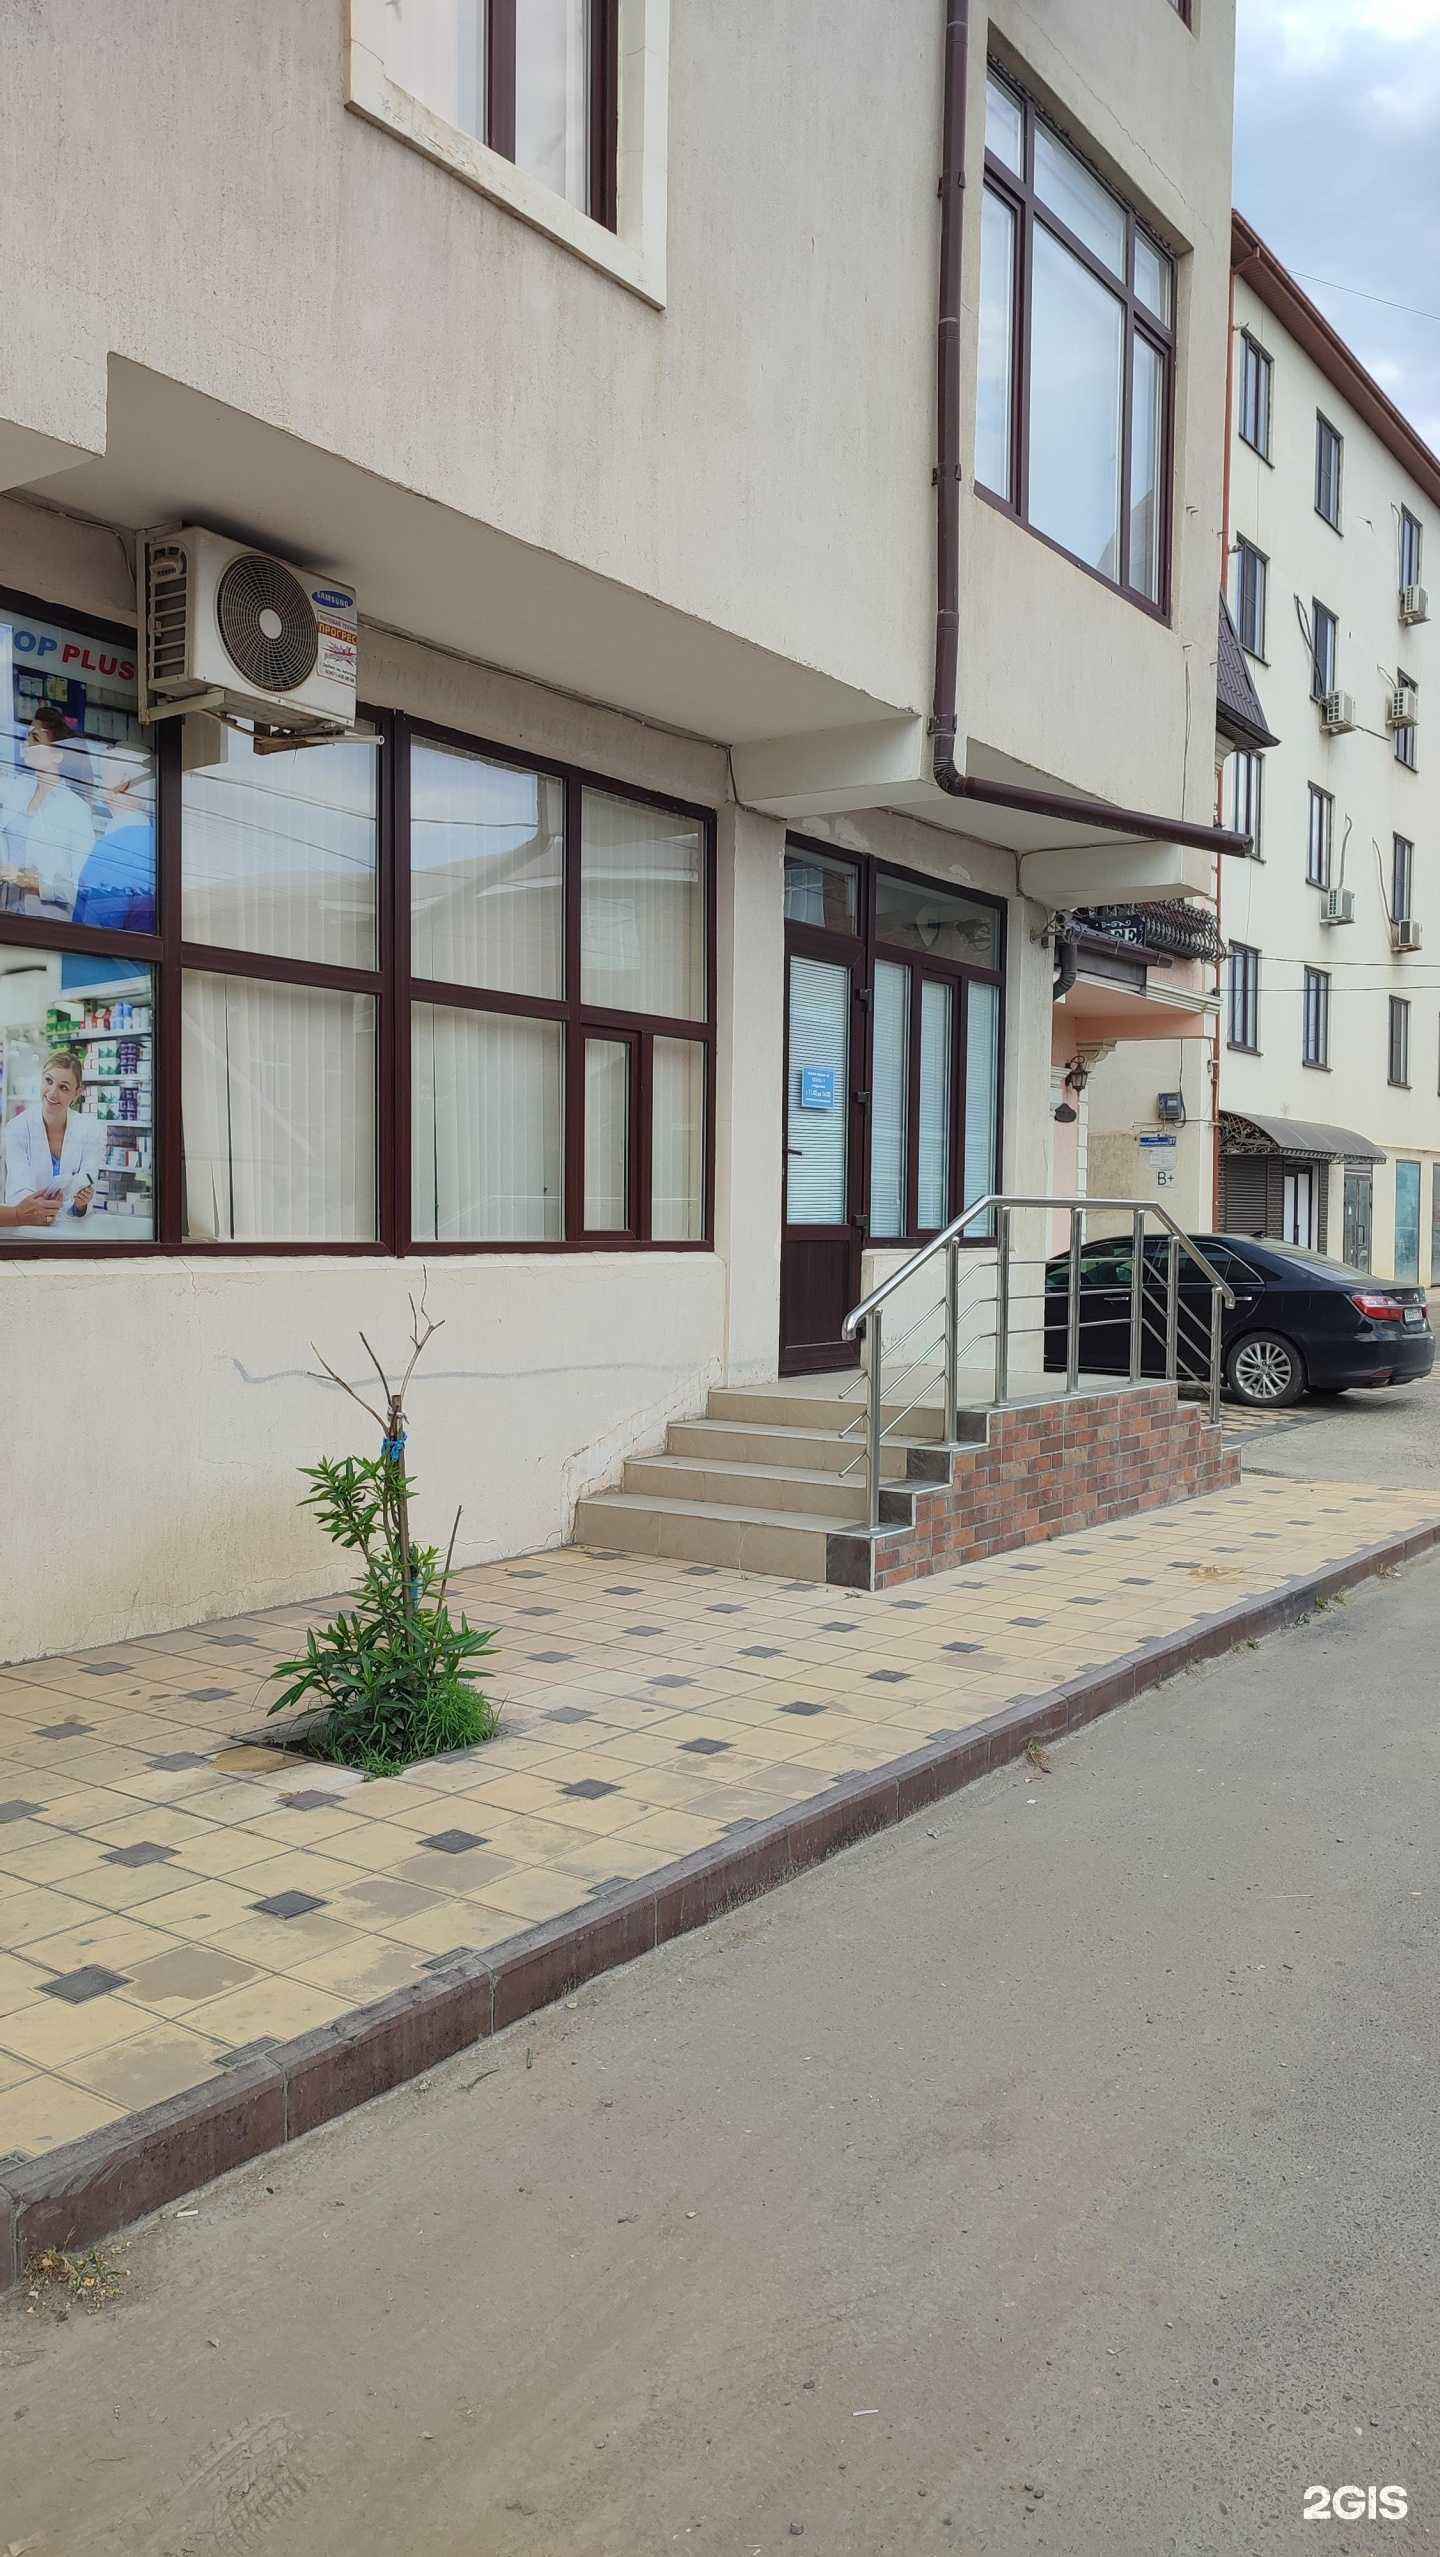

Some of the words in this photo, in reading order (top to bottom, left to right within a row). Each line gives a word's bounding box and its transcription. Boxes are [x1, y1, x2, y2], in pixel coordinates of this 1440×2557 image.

[316, 591, 350, 608] SAMSUNG
[12, 628, 57, 656] OP
[62, 644, 135, 681] PLUS
